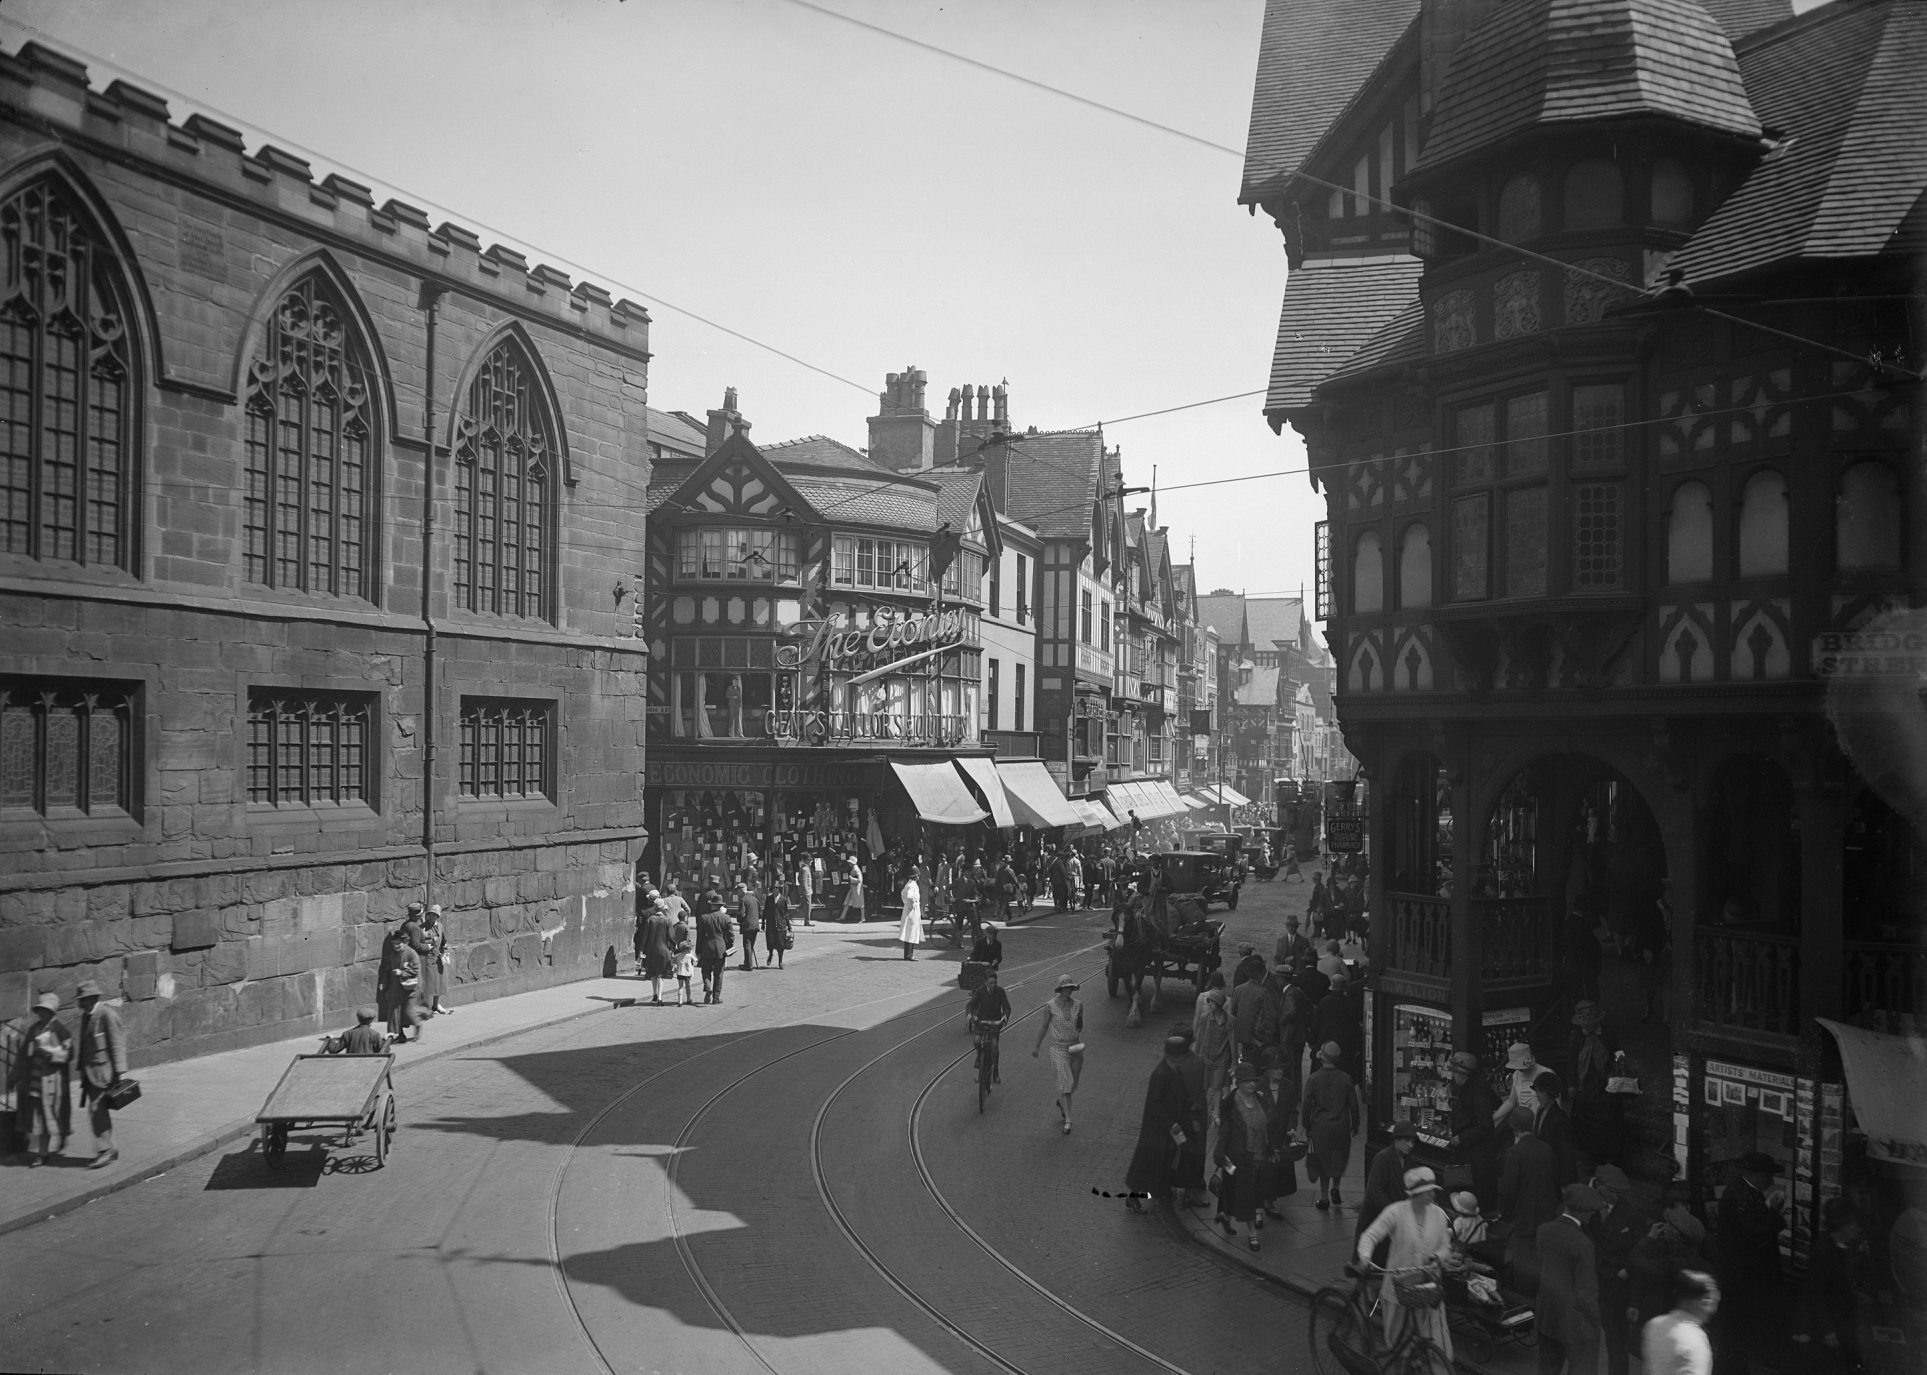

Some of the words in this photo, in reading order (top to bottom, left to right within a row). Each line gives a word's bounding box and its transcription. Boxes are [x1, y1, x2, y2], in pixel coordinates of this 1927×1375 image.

[776, 611, 862, 666] The
[764, 709, 826, 737] GENT'S
[829, 711, 903, 738] TAILORS
[649, 763, 750, 785] ECONOMIC
[762, 765, 858, 785] CLOTHING
[1749, 1070, 1796, 1088] MATERIALS
